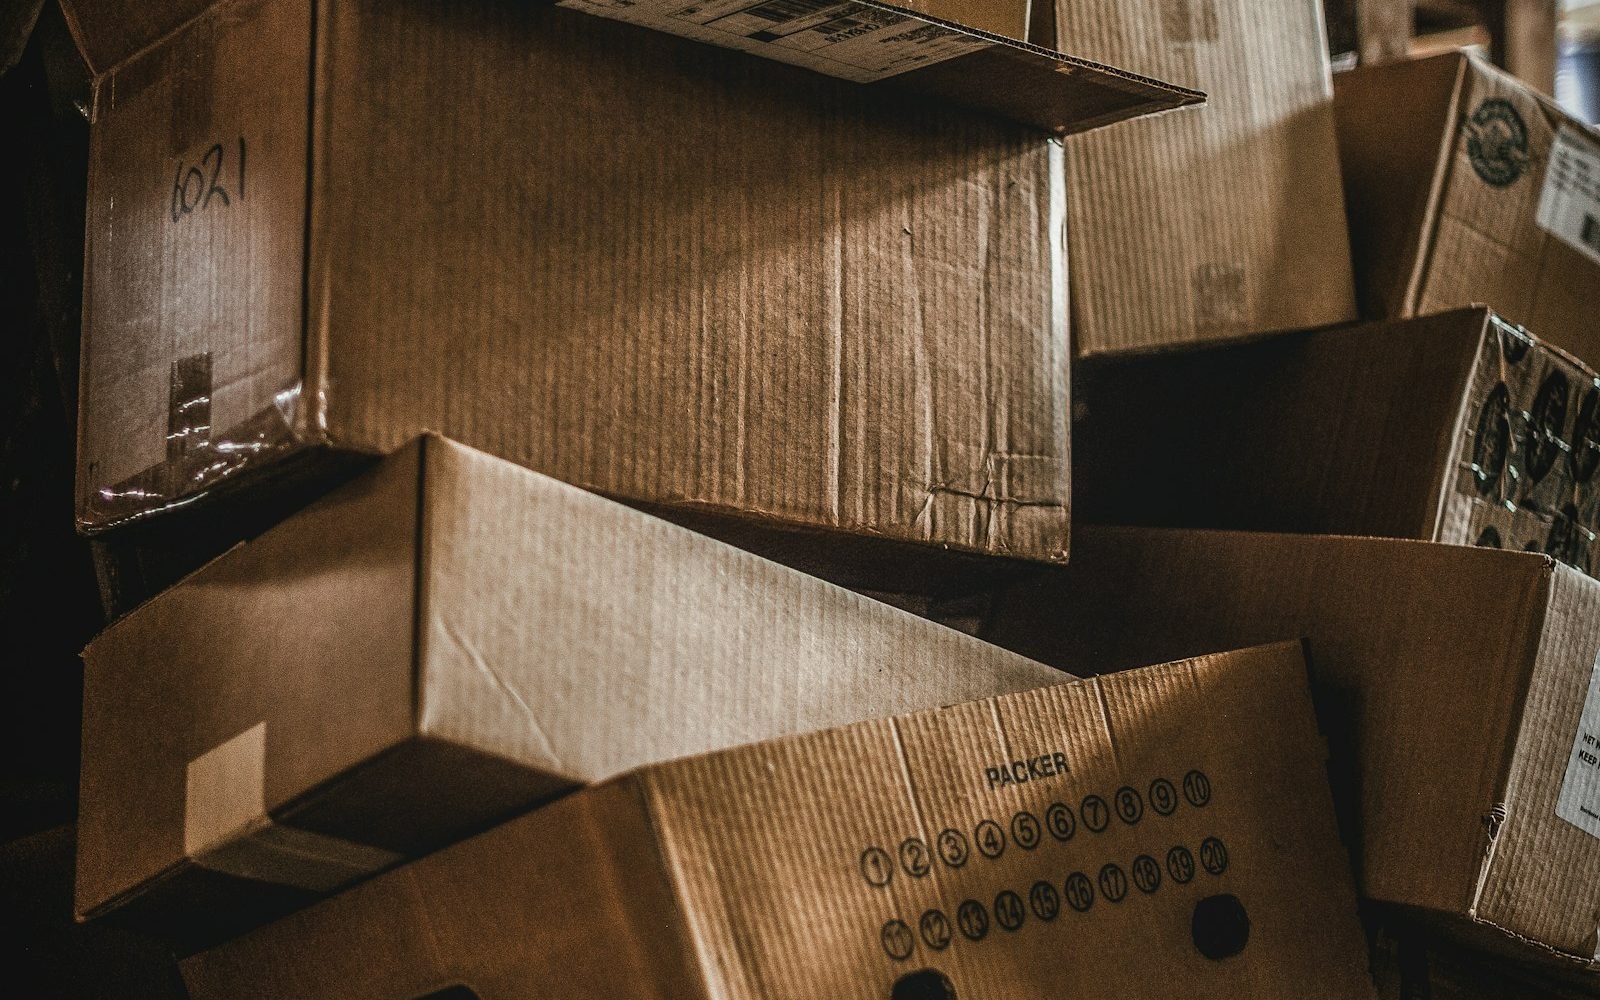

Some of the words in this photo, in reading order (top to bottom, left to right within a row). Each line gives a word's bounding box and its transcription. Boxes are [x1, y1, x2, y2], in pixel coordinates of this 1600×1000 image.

[172, 136, 246, 223] 6021
[985, 751, 1070, 791] PACKER
[1578, 748, 1598, 766] KEEP
